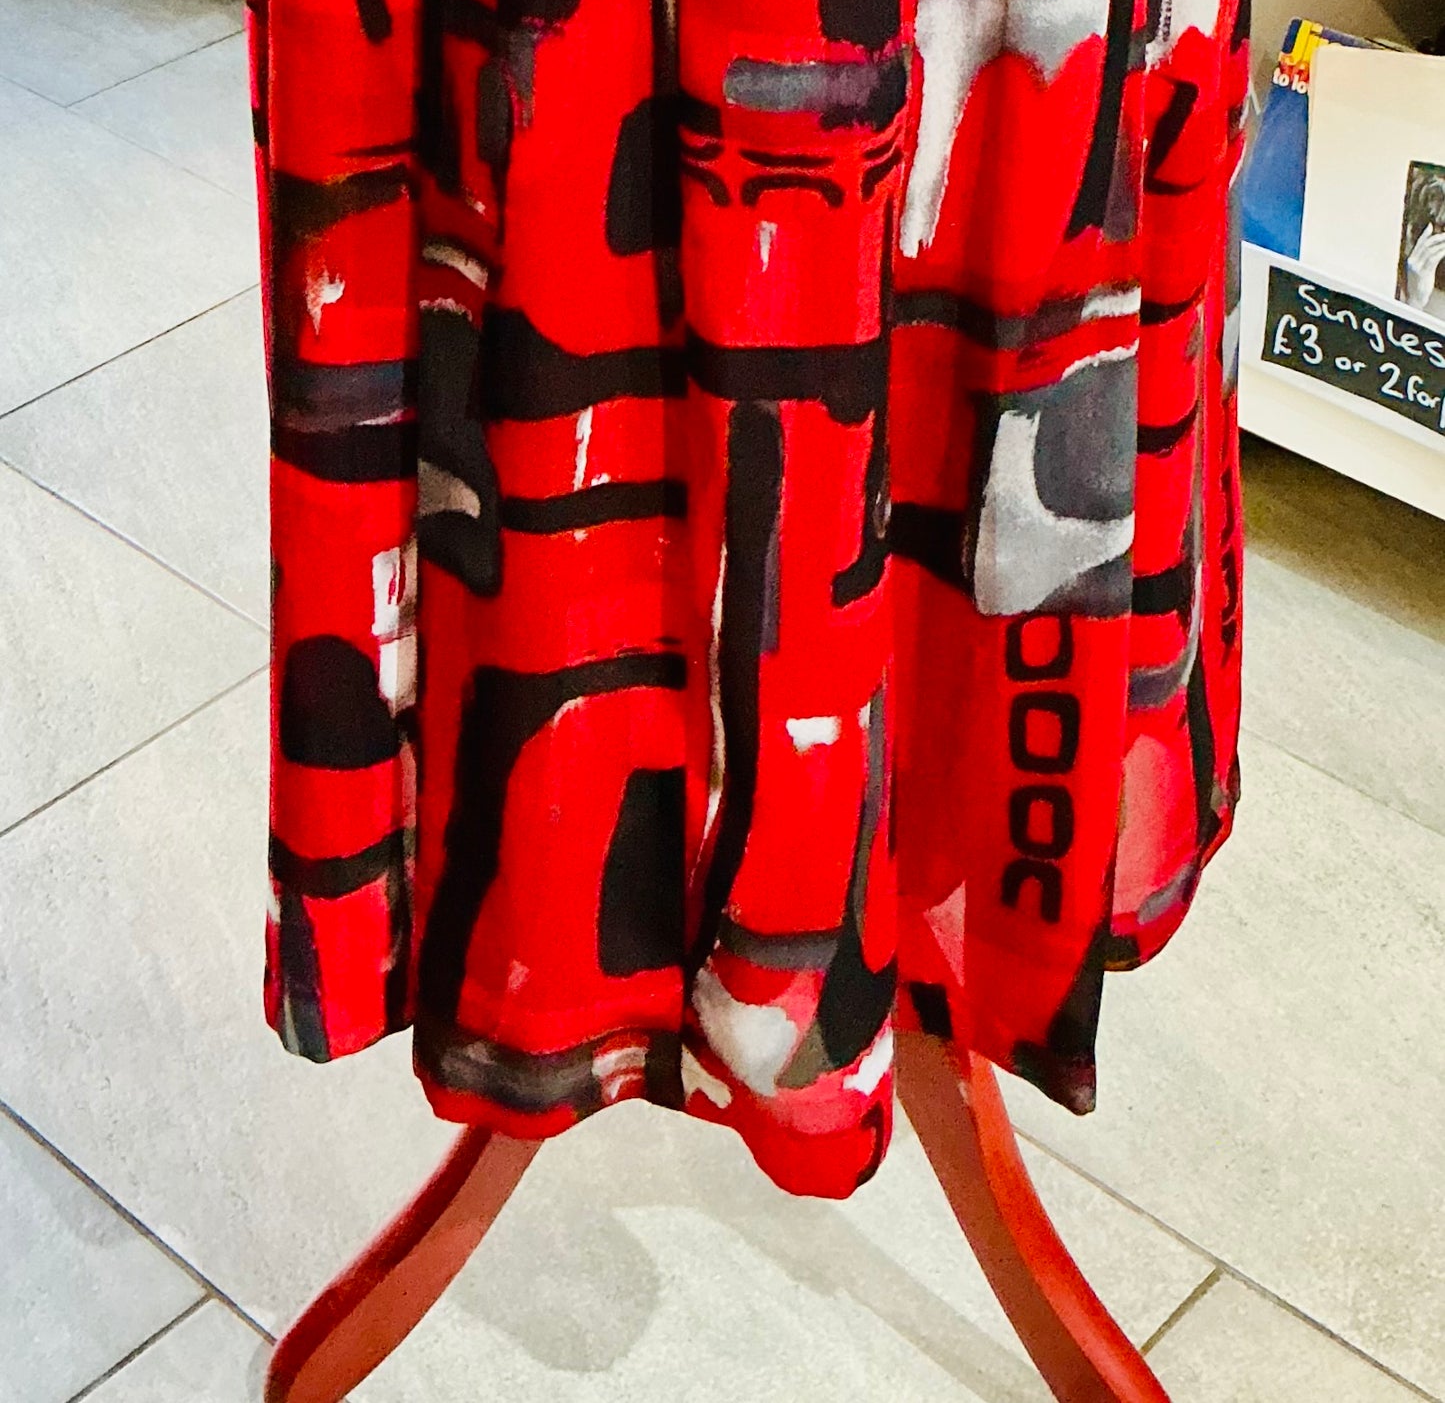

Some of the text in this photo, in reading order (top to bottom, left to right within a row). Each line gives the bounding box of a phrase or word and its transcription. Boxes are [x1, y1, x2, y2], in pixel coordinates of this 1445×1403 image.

[1273, 314, 1324, 365] £3
[1334, 356, 1366, 373] or
[1298, 283, 1445, 369] Singles
